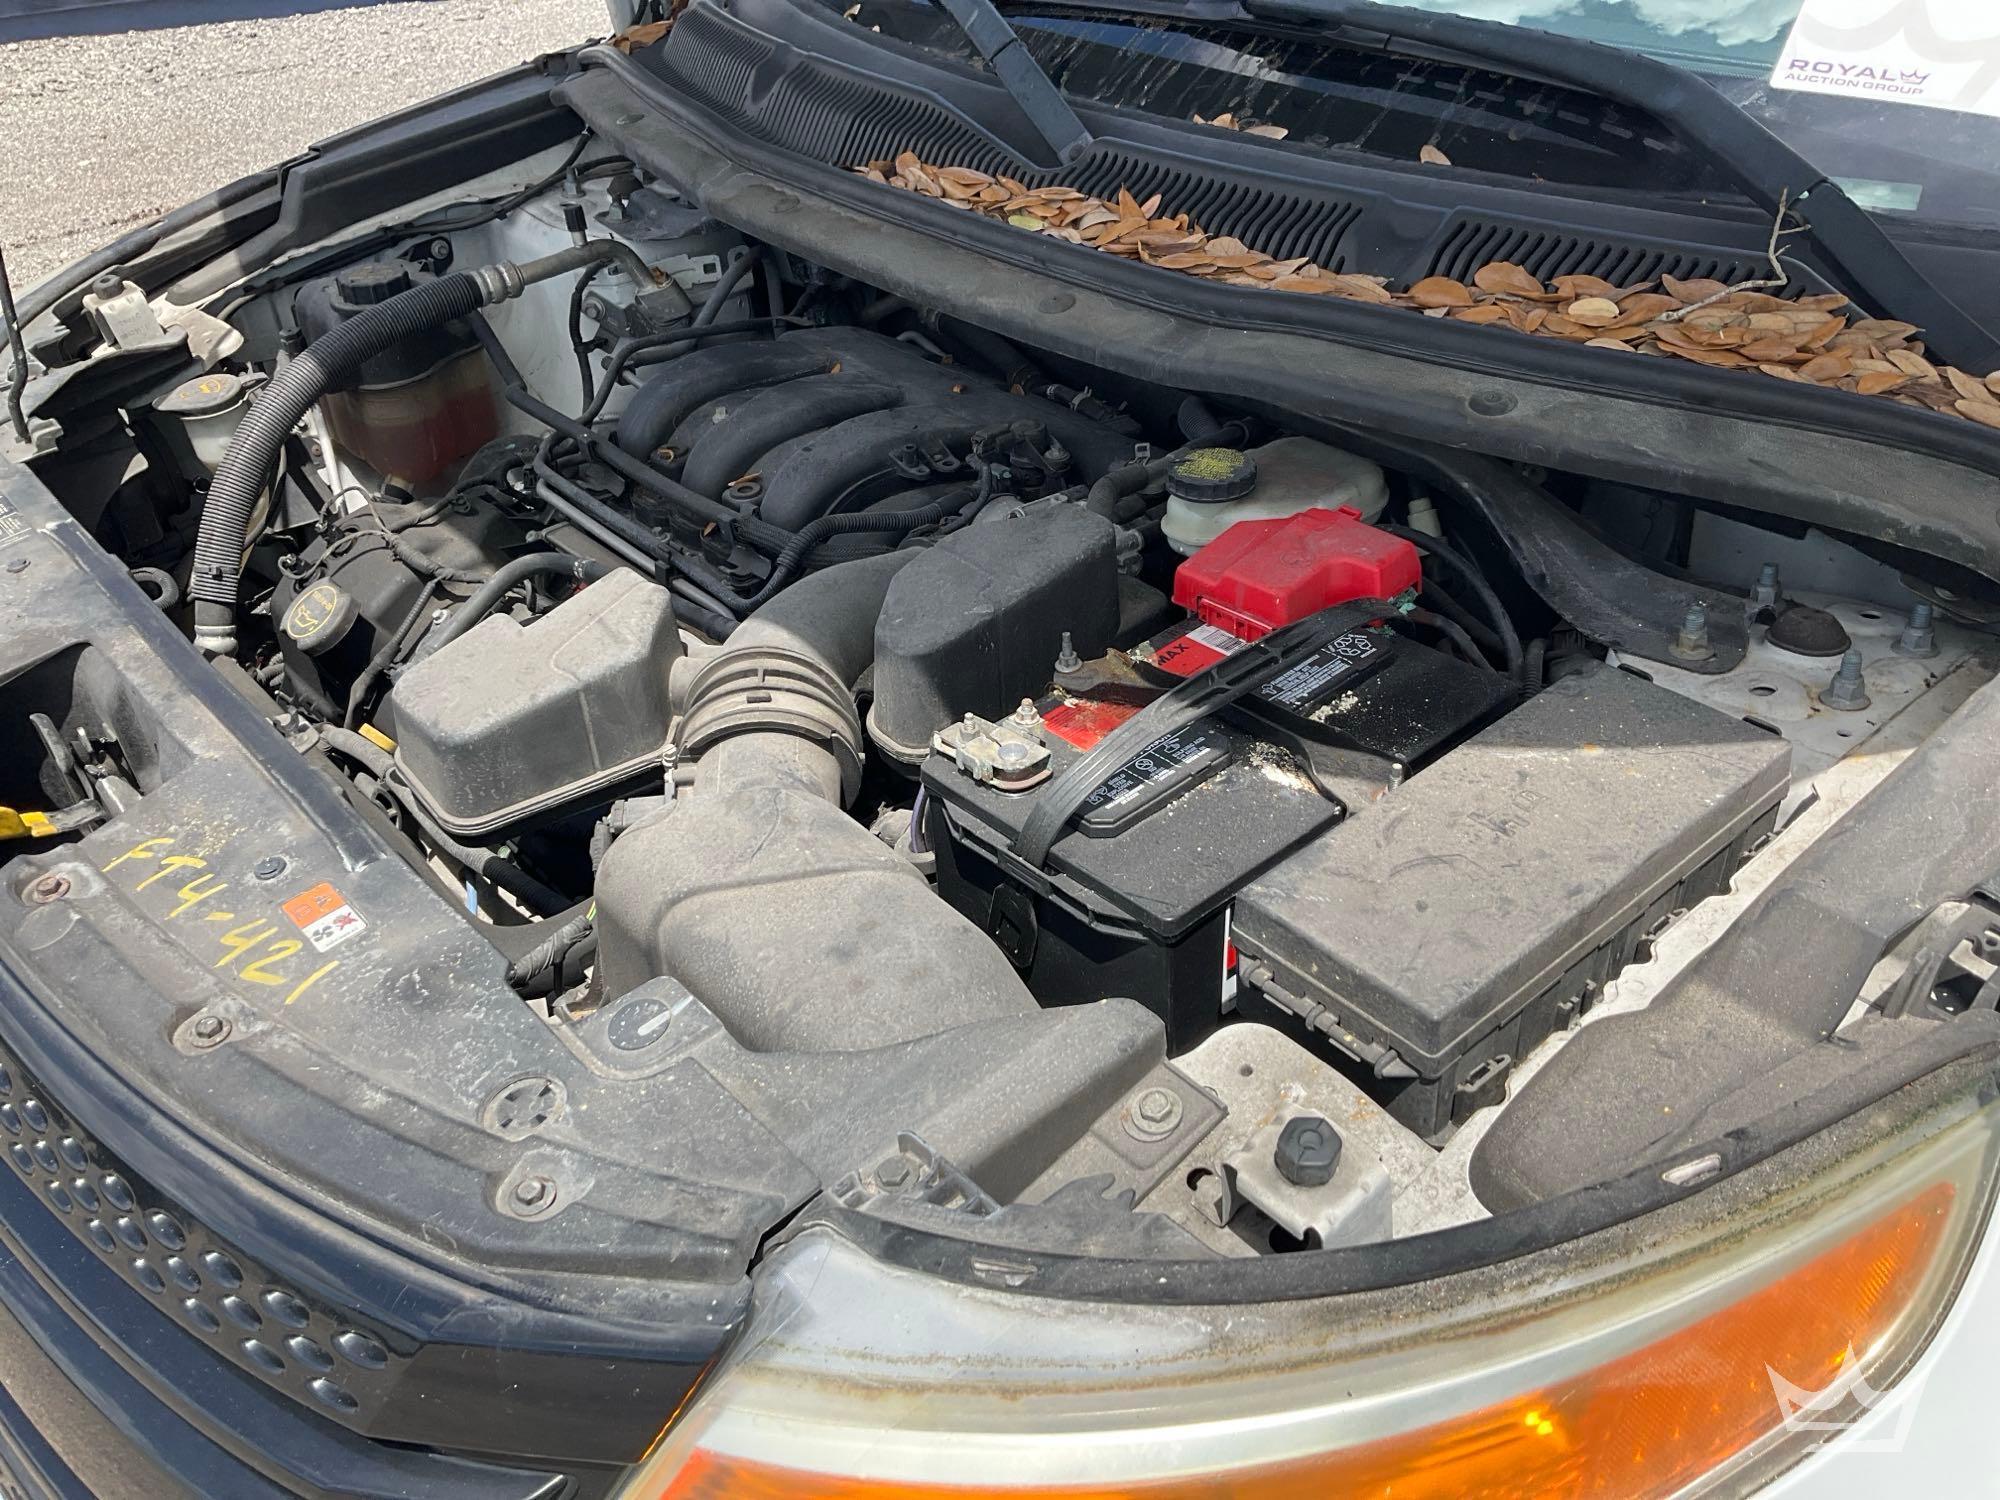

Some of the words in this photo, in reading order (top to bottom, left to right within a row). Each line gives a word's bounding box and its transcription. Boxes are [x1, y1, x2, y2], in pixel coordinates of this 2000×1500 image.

[1788, 59, 1897, 82] ROYAL
[1785, 73, 1859, 88] AUCTION
[1863, 82, 1924, 95] GROUP
[1158, 644, 1189, 665] MAX
